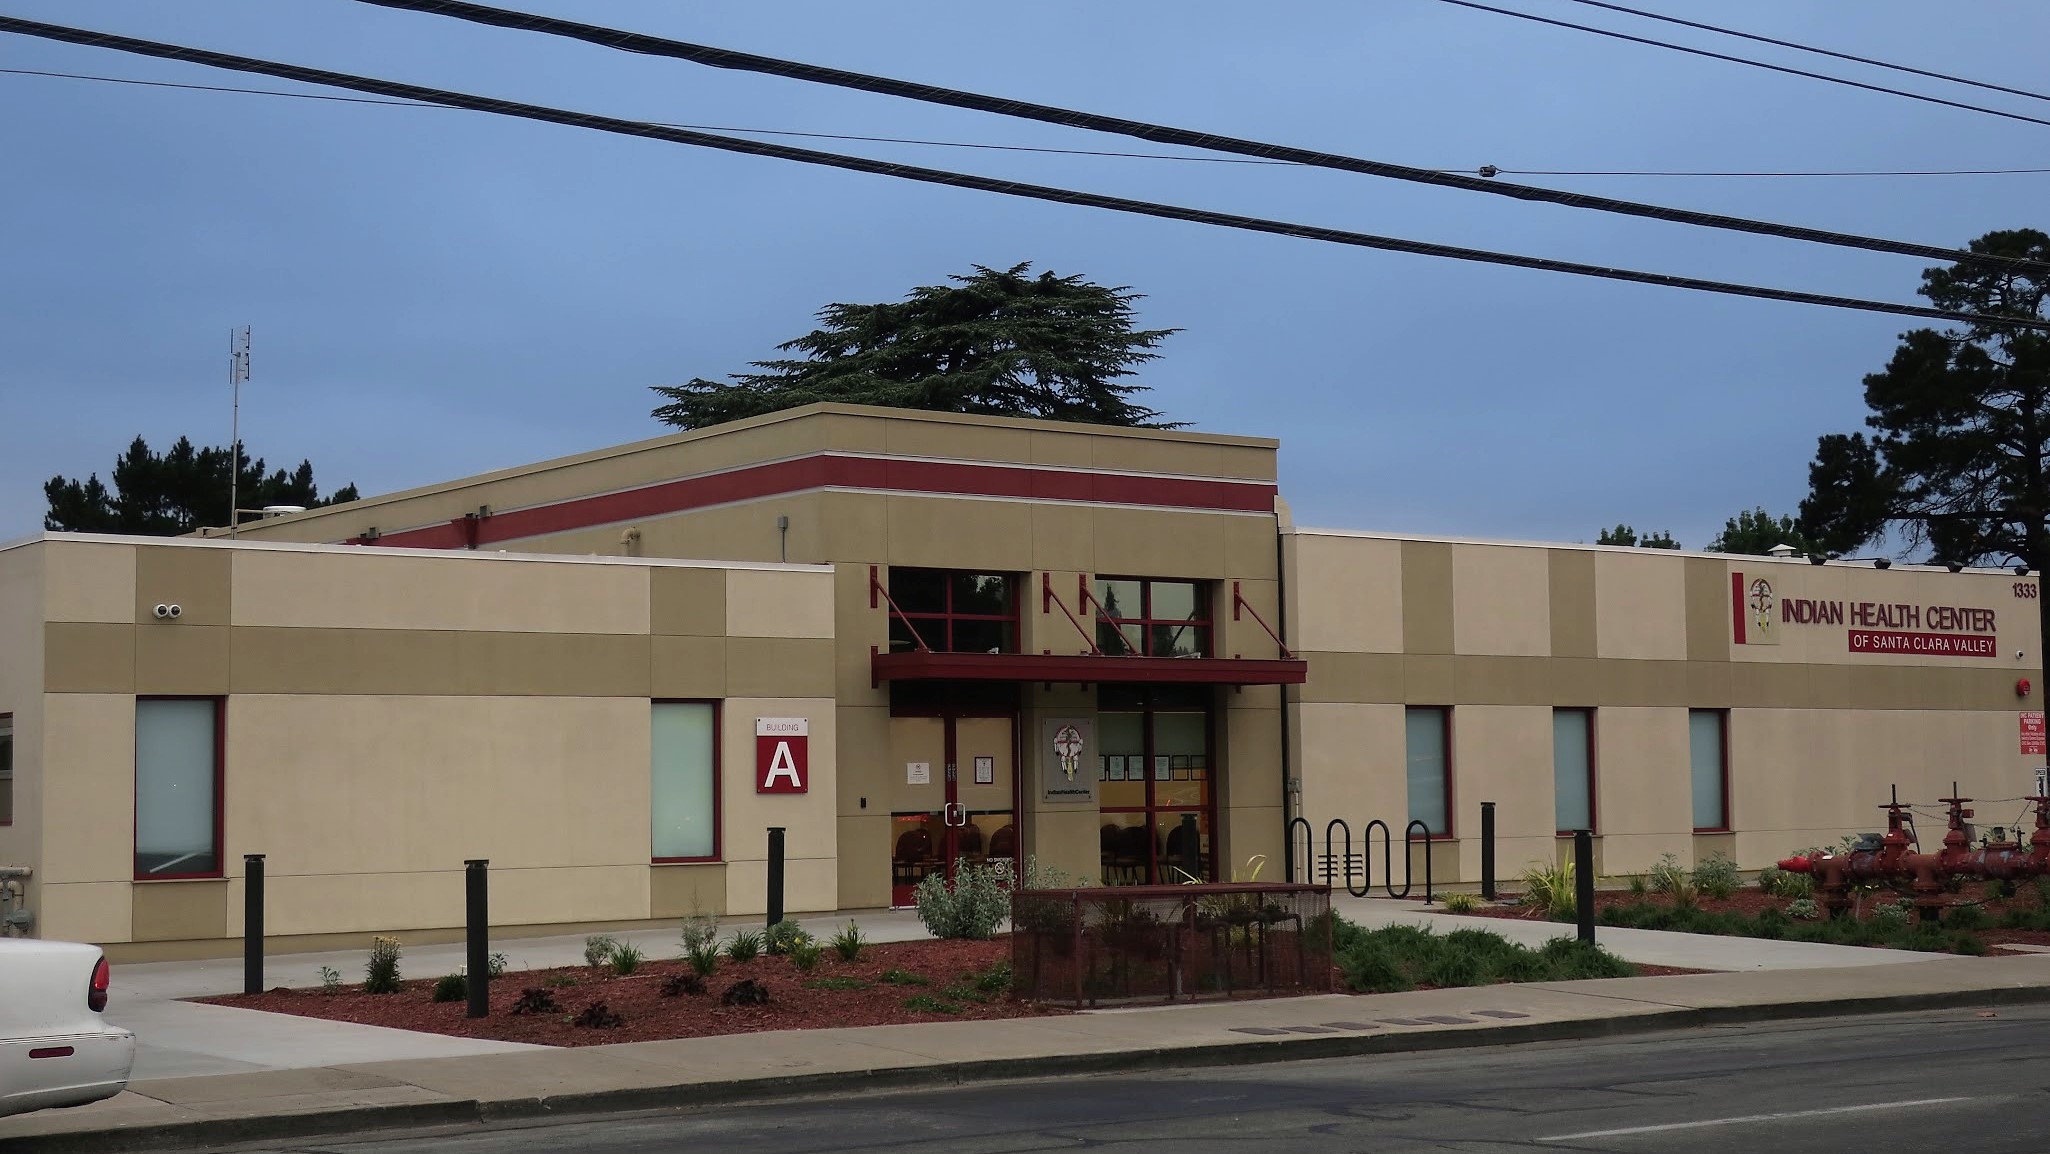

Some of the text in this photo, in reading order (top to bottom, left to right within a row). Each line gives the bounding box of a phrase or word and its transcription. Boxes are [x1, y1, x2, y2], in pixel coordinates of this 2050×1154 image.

[2012, 582, 2037, 598] 1333
[1782, 598, 1996, 632] INDIAN HEALTH CENTER
[1853, 634, 1993, 652] OF SANTA CLARA VALLEY
[766, 723, 799, 732] BUILDING
[764, 742, 802, 788] A
